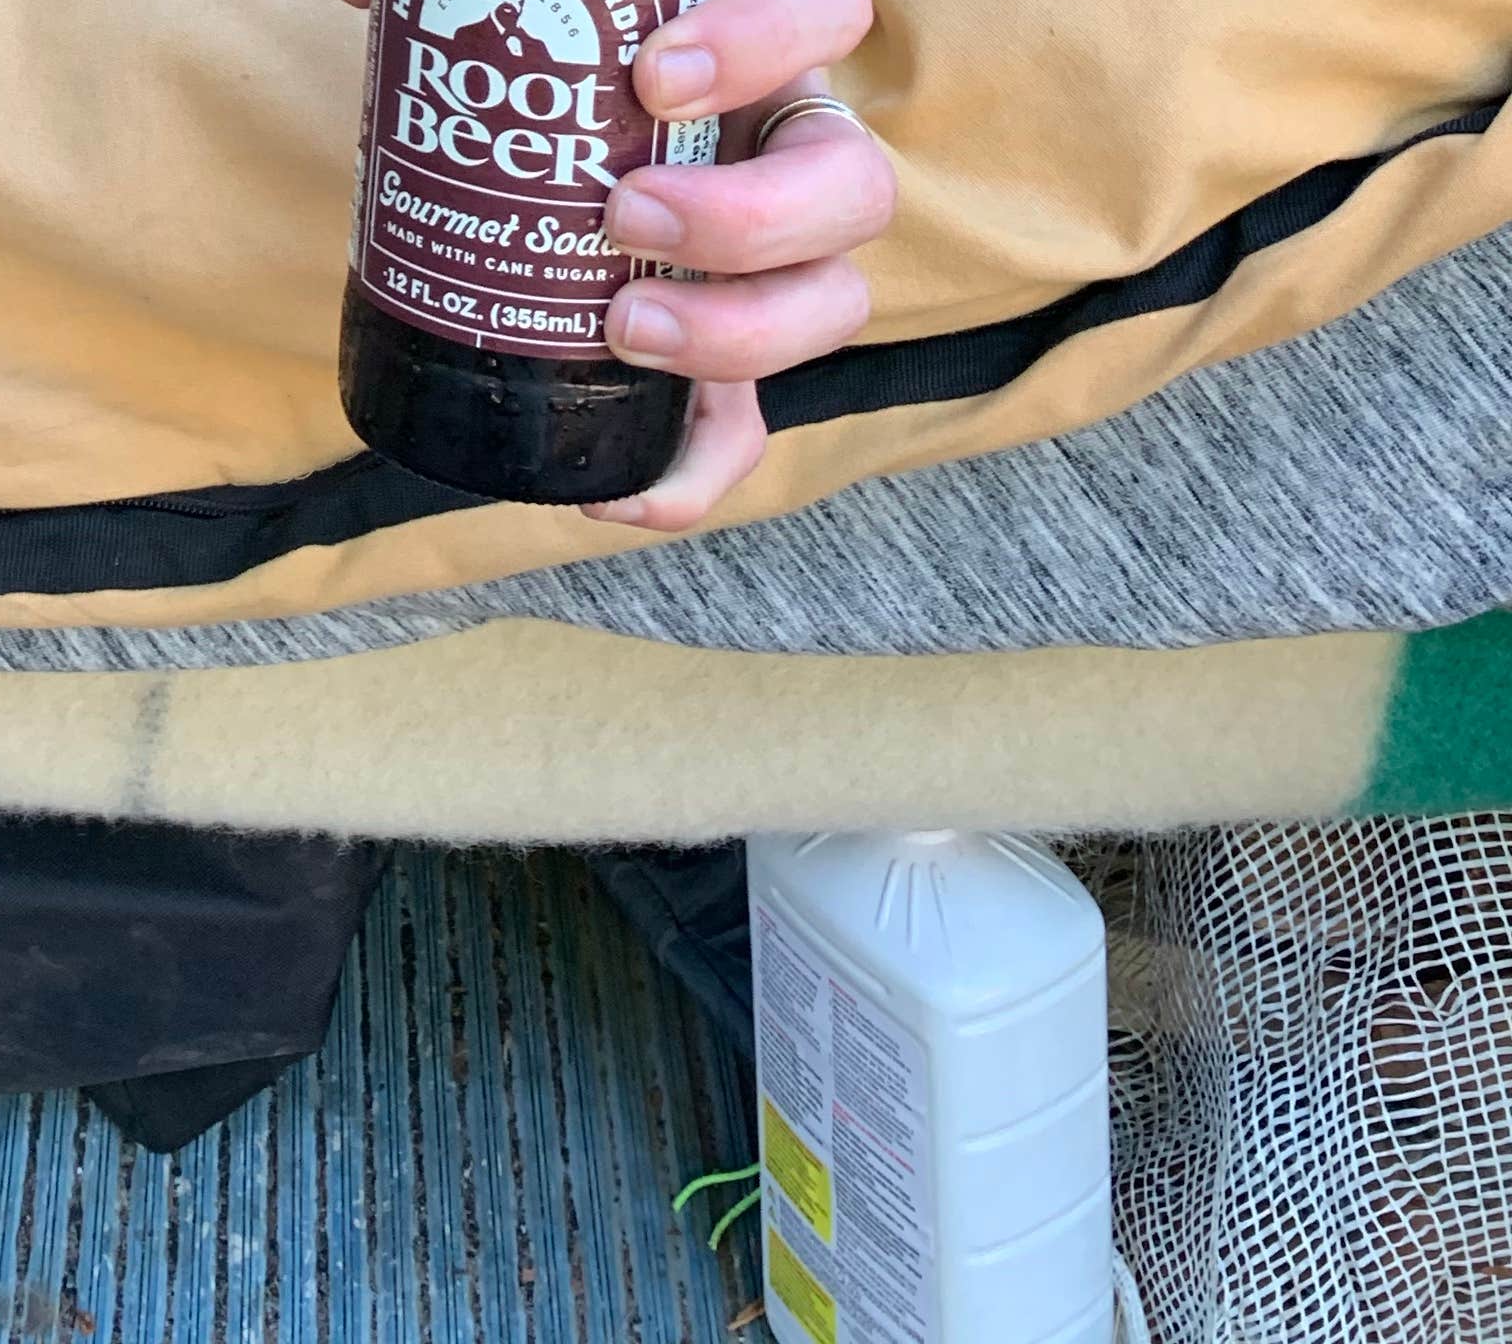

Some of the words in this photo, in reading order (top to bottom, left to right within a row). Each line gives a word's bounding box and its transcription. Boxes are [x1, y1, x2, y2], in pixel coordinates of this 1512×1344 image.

[379, 170, 520, 246] Gourmet
[431, 240, 476, 265] WITH
[485, 257, 533, 277] CANE
[544, 267, 606, 281] SUGAR
[387, 267, 407, 294] 12
[490, 303, 597, 337] (355mL)
